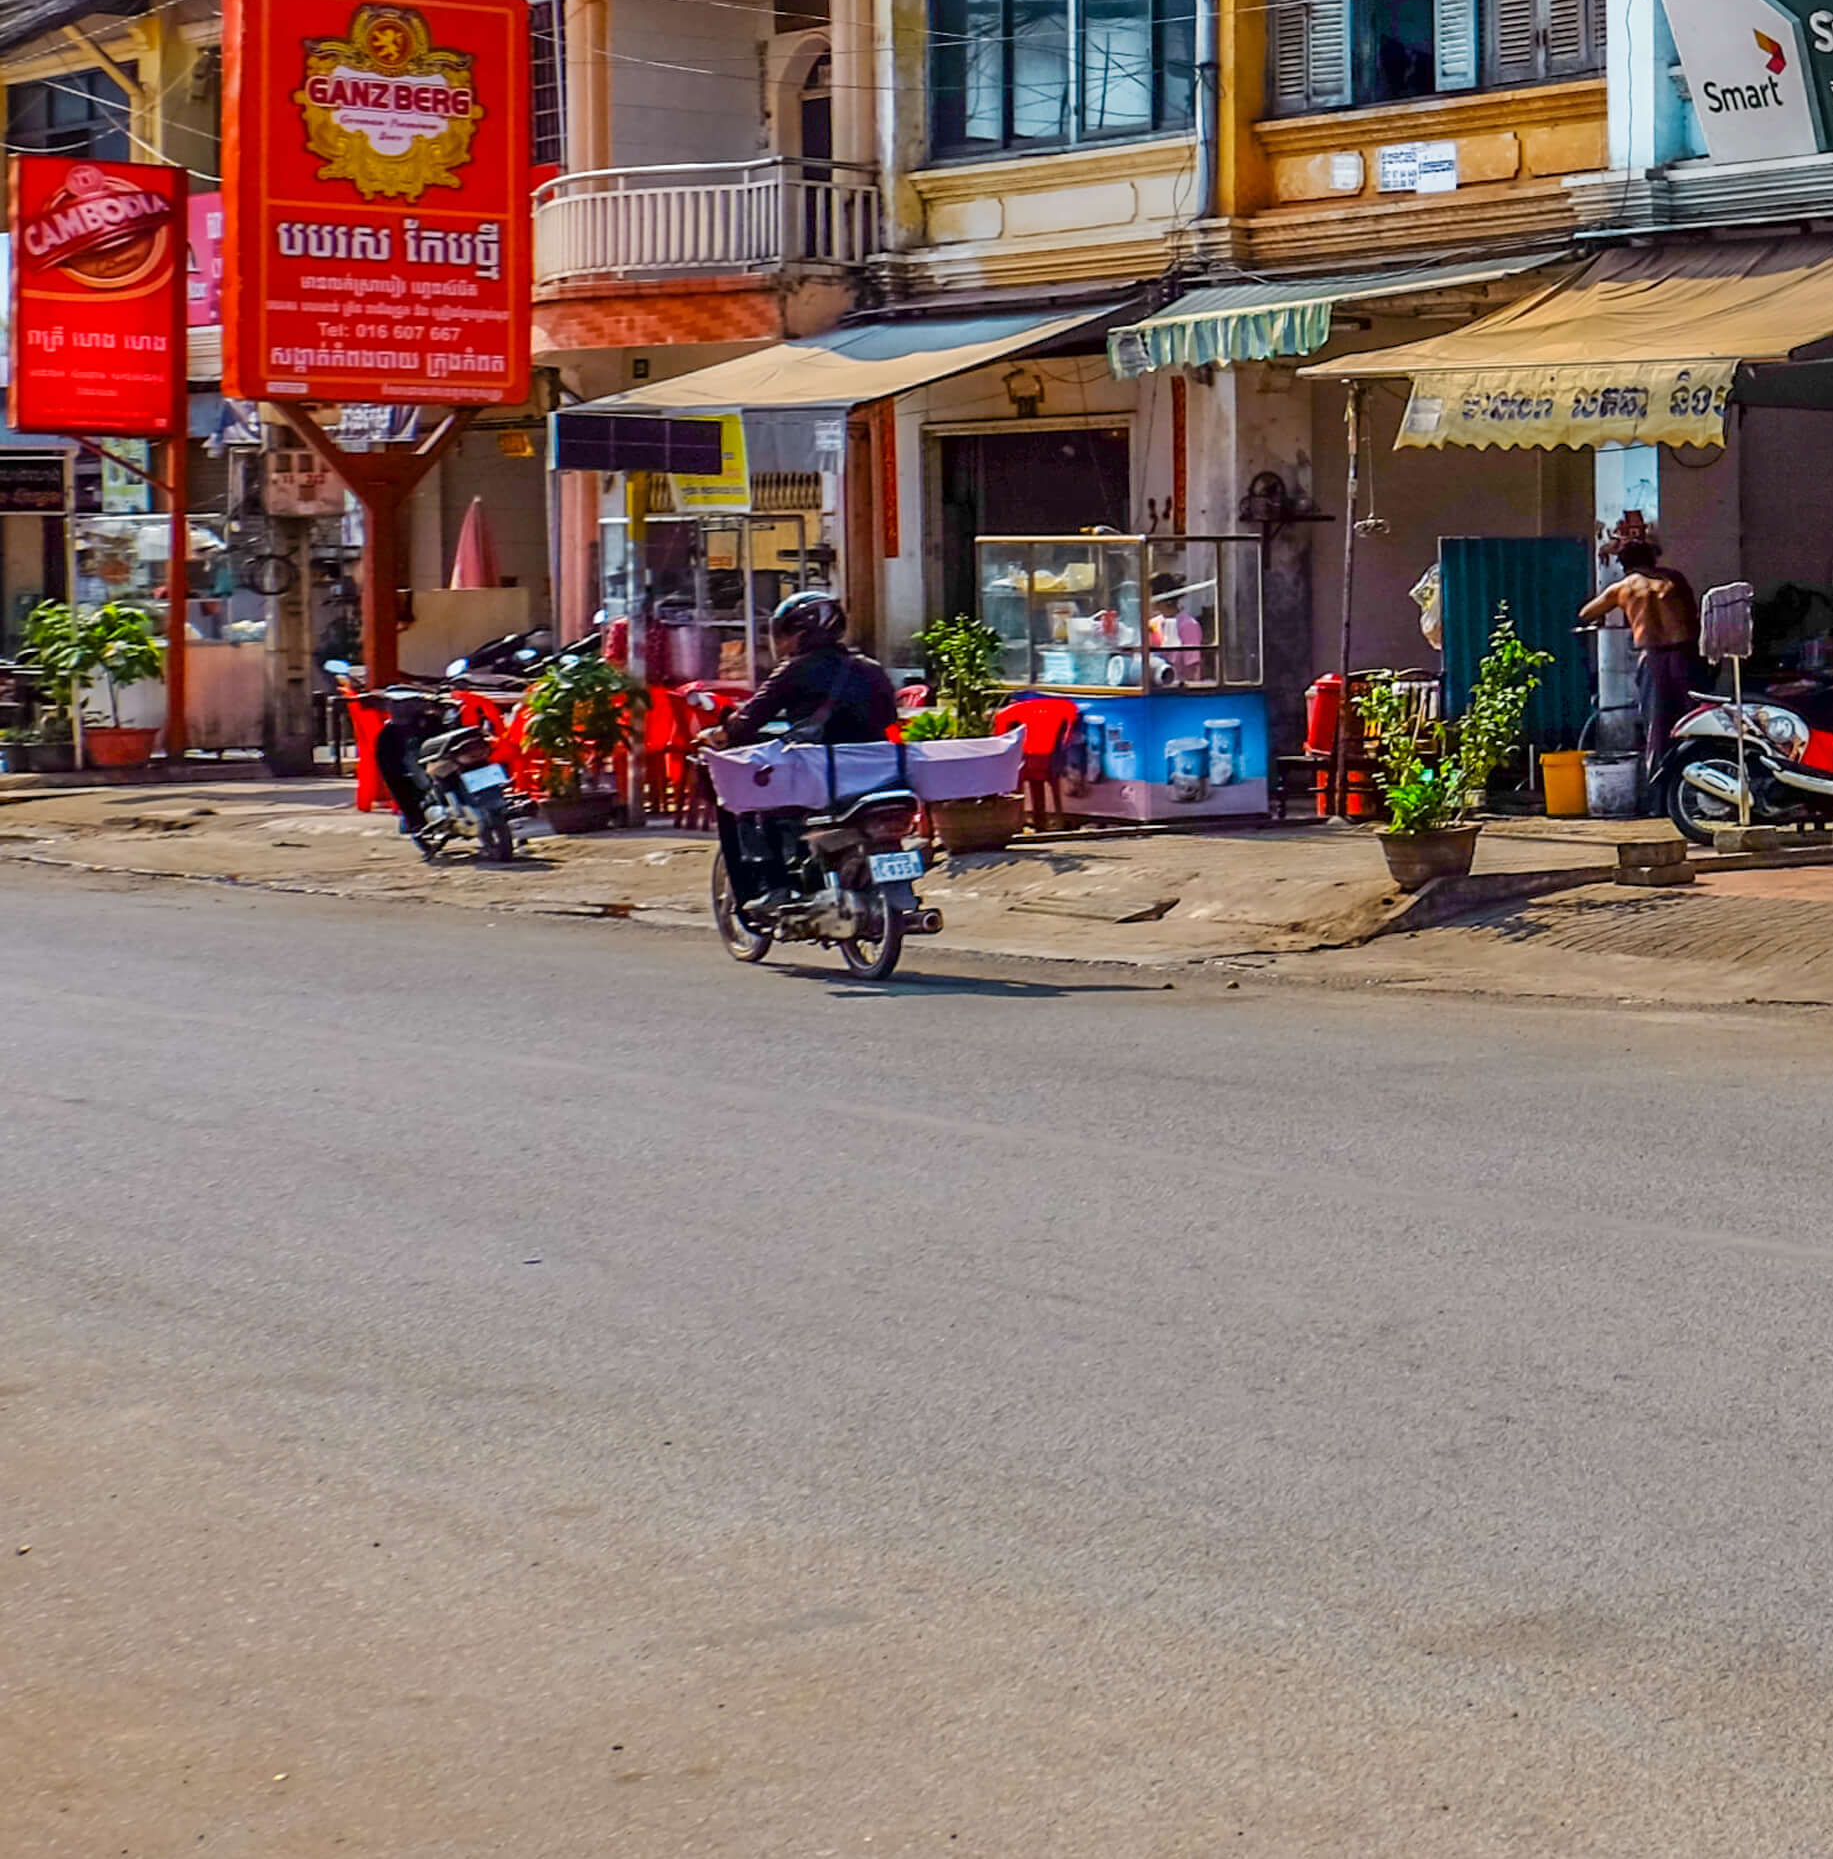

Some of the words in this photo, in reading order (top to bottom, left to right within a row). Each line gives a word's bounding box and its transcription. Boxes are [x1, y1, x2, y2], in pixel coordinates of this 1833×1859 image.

[1703, 75, 1784, 114] Smart
[24, 193, 170, 256] CAMBODIA
[276, 222, 391, 261] បបរស
[317, 322, 350, 338] Tel:
[355, 323, 389, 339] 016
